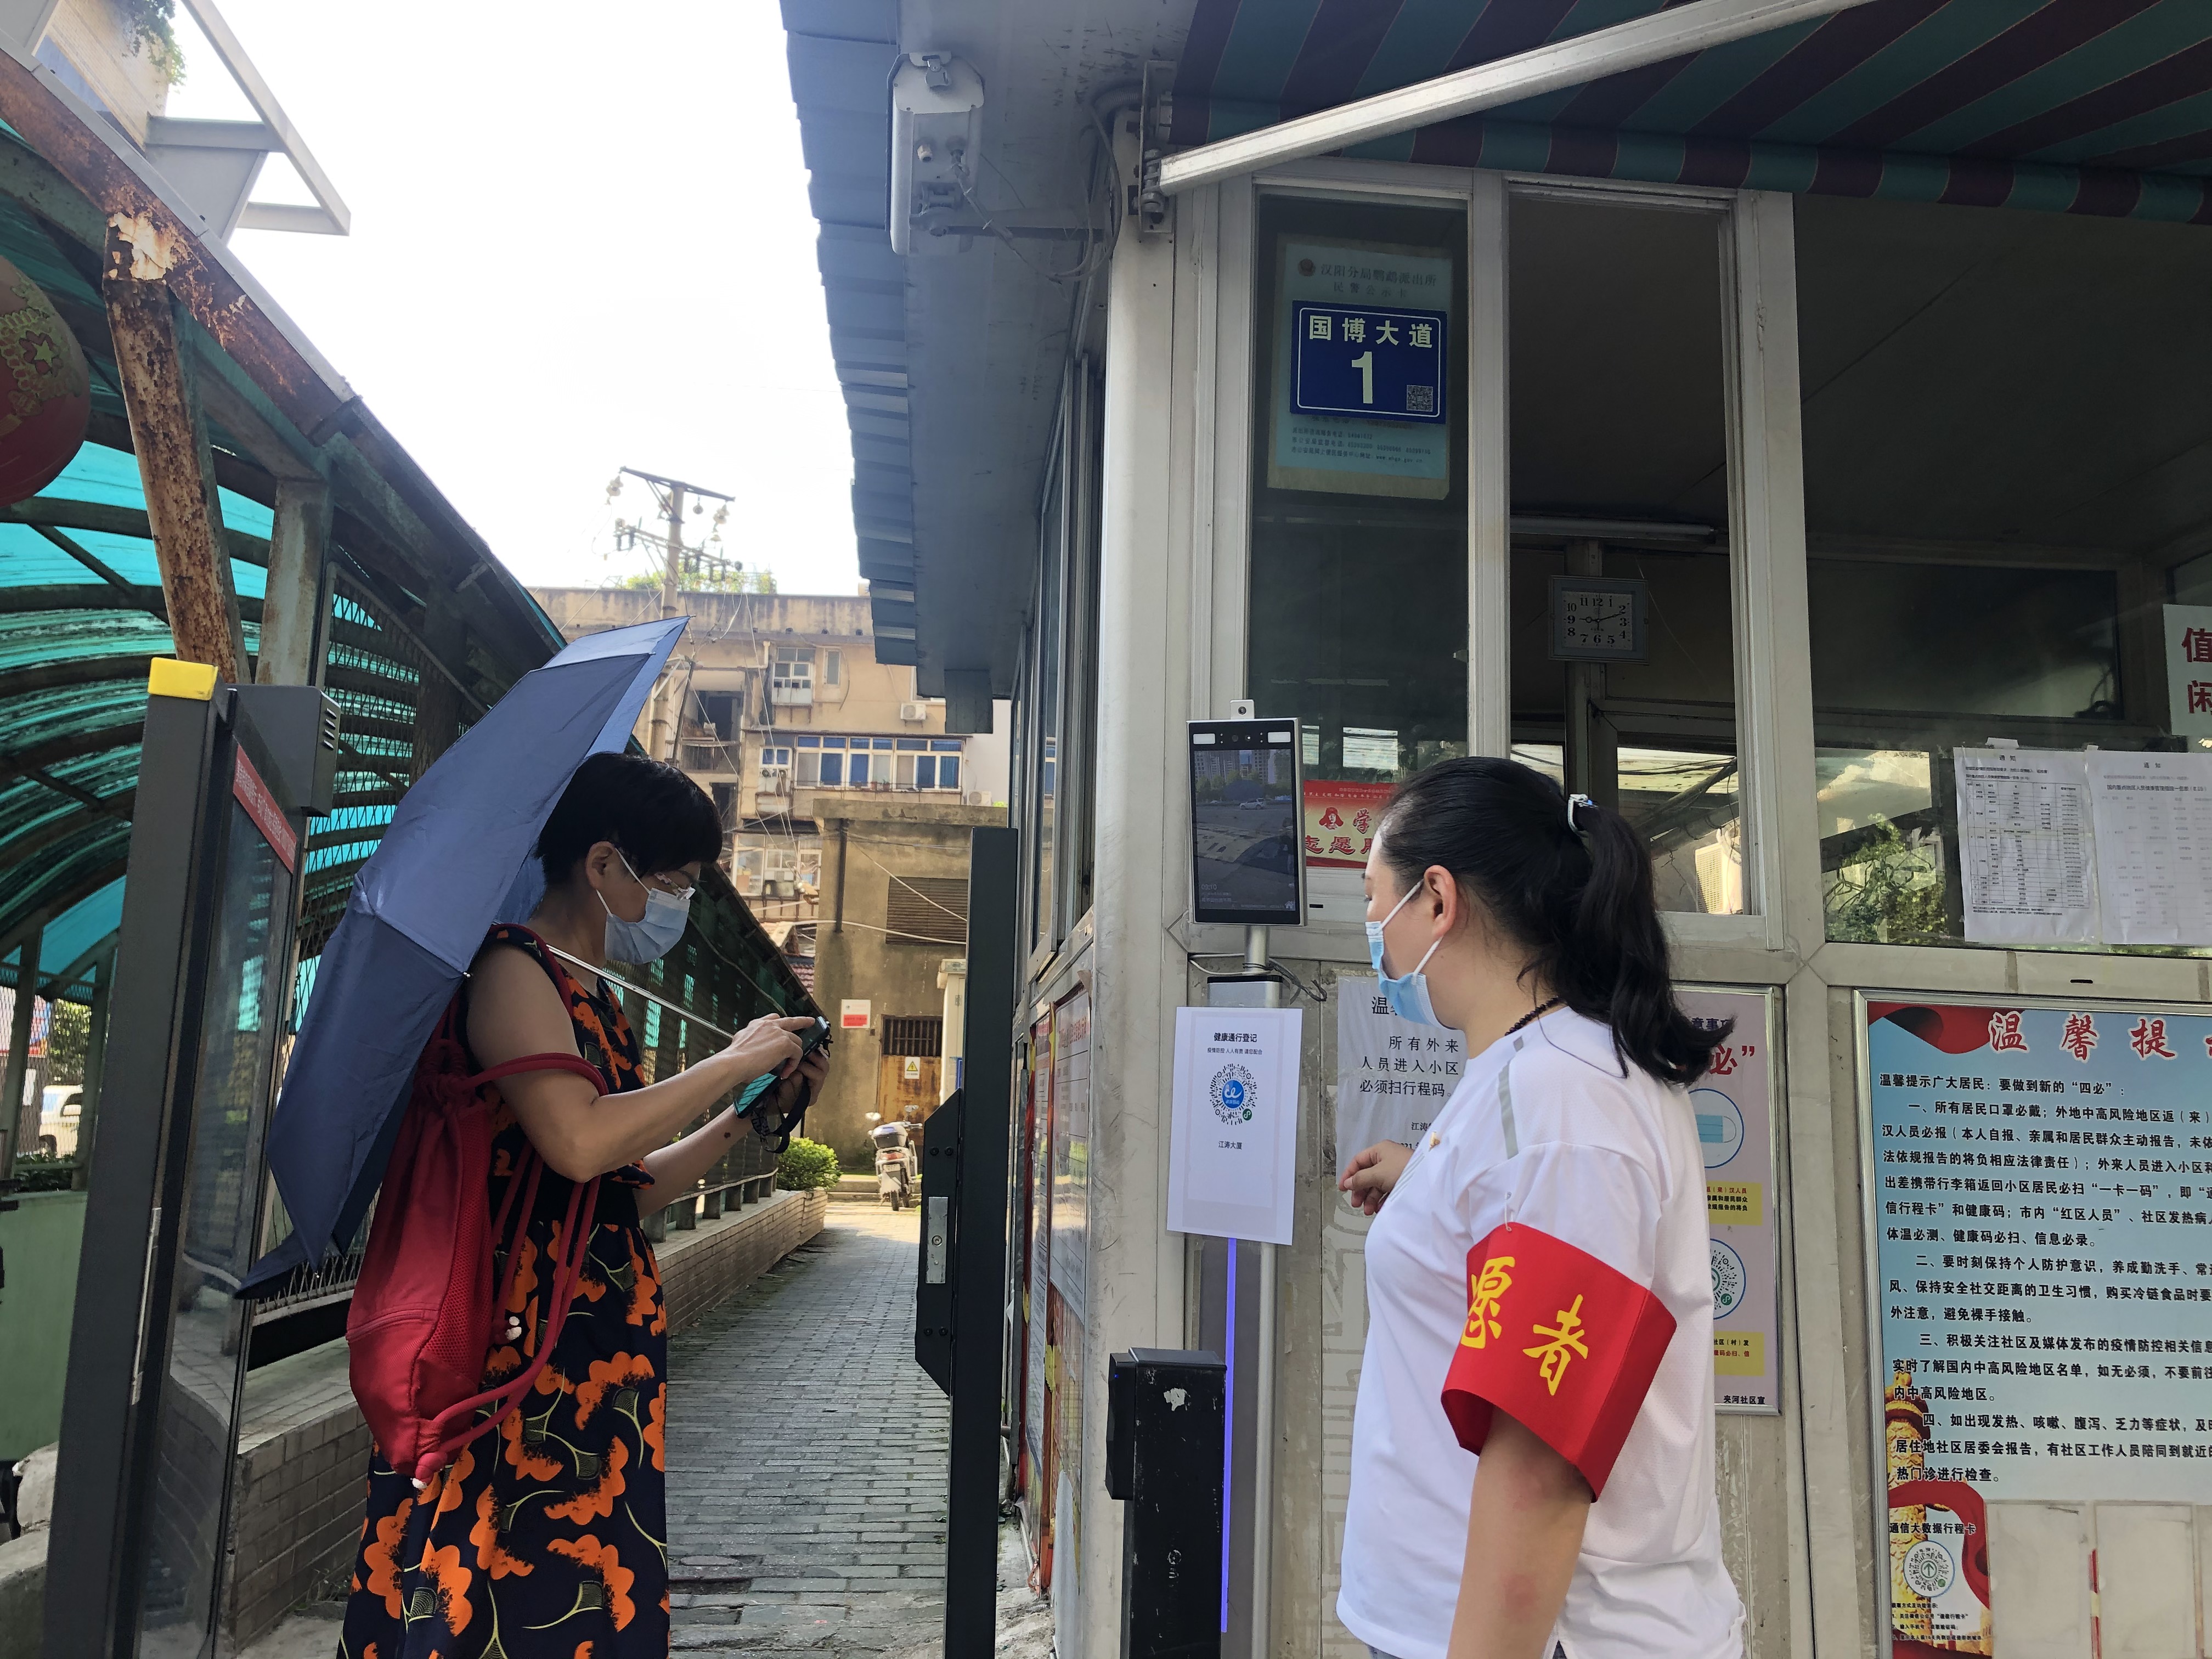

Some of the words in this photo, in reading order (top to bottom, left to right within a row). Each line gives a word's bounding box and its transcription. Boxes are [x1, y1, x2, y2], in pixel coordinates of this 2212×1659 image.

[1310, 315, 1432, 348] 国博大道
[1351, 351, 1373, 404] 1
[1567, 603, 1577, 612] 10
[1580, 597, 1588, 606] 11
[1593, 598, 1603, 606] 12
[1609, 598, 1612, 607] 1
[1619, 605, 1626, 614] 2
[1567, 615, 1576, 624] 9
[1620, 618, 1627, 627] 3
[1567, 628, 1576, 636] 8
[1580, 634, 1589, 643] 7
[1619, 630, 1626, 639] 4
[1594, 635, 1601, 644] 6
[1607, 635, 1615, 644] 5
[2181, 627, 2212, 662] 值
[1353, 808, 1371, 834] 学
[1372, 996, 1398, 1015] 温
[1691, 1017, 1730, 1030] 意事
[1214, 1032, 1257, 1042] 健康通行登记
[1990, 1011, 2212, 1060] 温馨提
[1389, 1036, 1459, 1053] 所有外来
[1361, 1056, 1459, 1075] 人员进入小区
[1360, 1079, 1451, 1097] 必须扫行程码。
[1412, 1122, 1431, 1131] 江涛
[1218, 1141, 1242, 1150] 江涛大厦
[1916, 1255, 2212, 1276] 二、要时刻保持个人防护意识，养成勤洗手、常
[1891, 1306, 2032, 1323] 外注意，避免裸手接触。
[1894, 1386, 1995, 1401] 内中高风险地区。
[1923, 1413, 2212, 1432] 四、如出现发热、咳嗽、腹泻、乏力等症状，及
[1895, 1440, 2212, 1459] 居住地社区居委会报告，有社区工作人员陪同到就近
[1897, 1466, 1999, 1482] 热门诊进行检查。
[1890, 1522, 1976, 1536] 通信大数据行程卡
